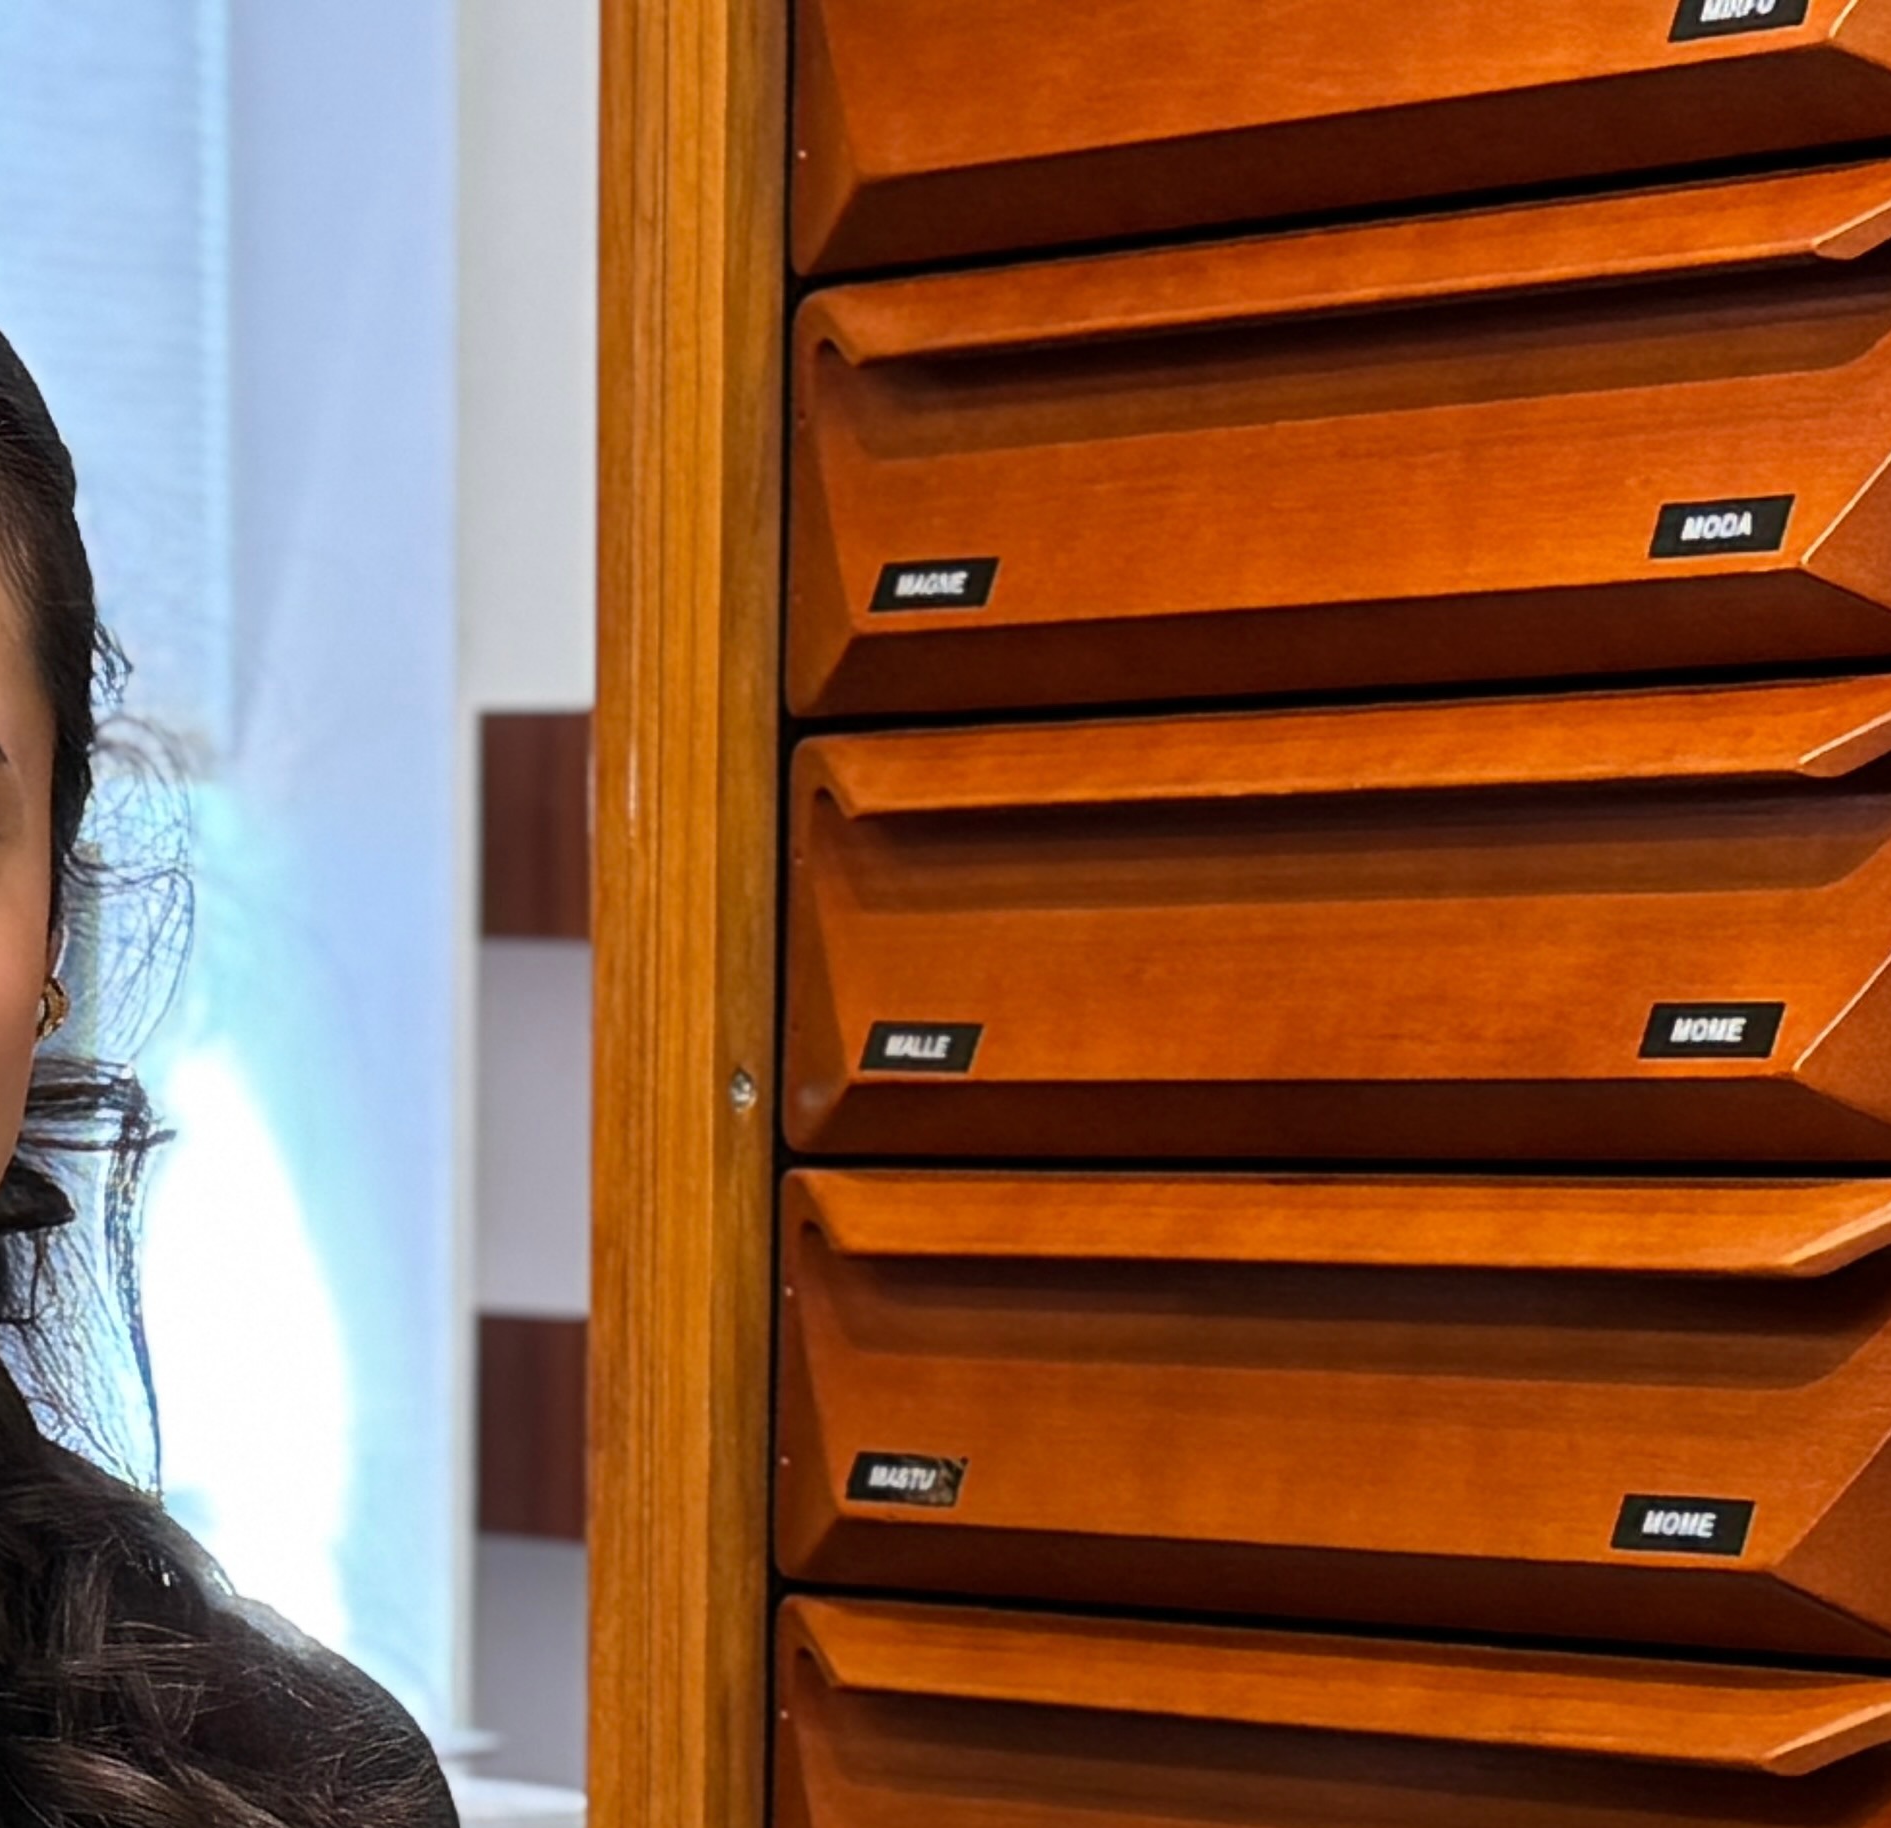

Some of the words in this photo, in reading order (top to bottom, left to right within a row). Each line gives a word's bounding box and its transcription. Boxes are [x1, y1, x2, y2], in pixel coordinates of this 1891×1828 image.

[1680, 511, 1753, 541] MODA
[1669, 1017, 1747, 1043] MOME
[884, 1034, 952, 1059] MALLE
[868, 1465, 937, 1491] MASTU
[1641, 1510, 1717, 1538] MOME
